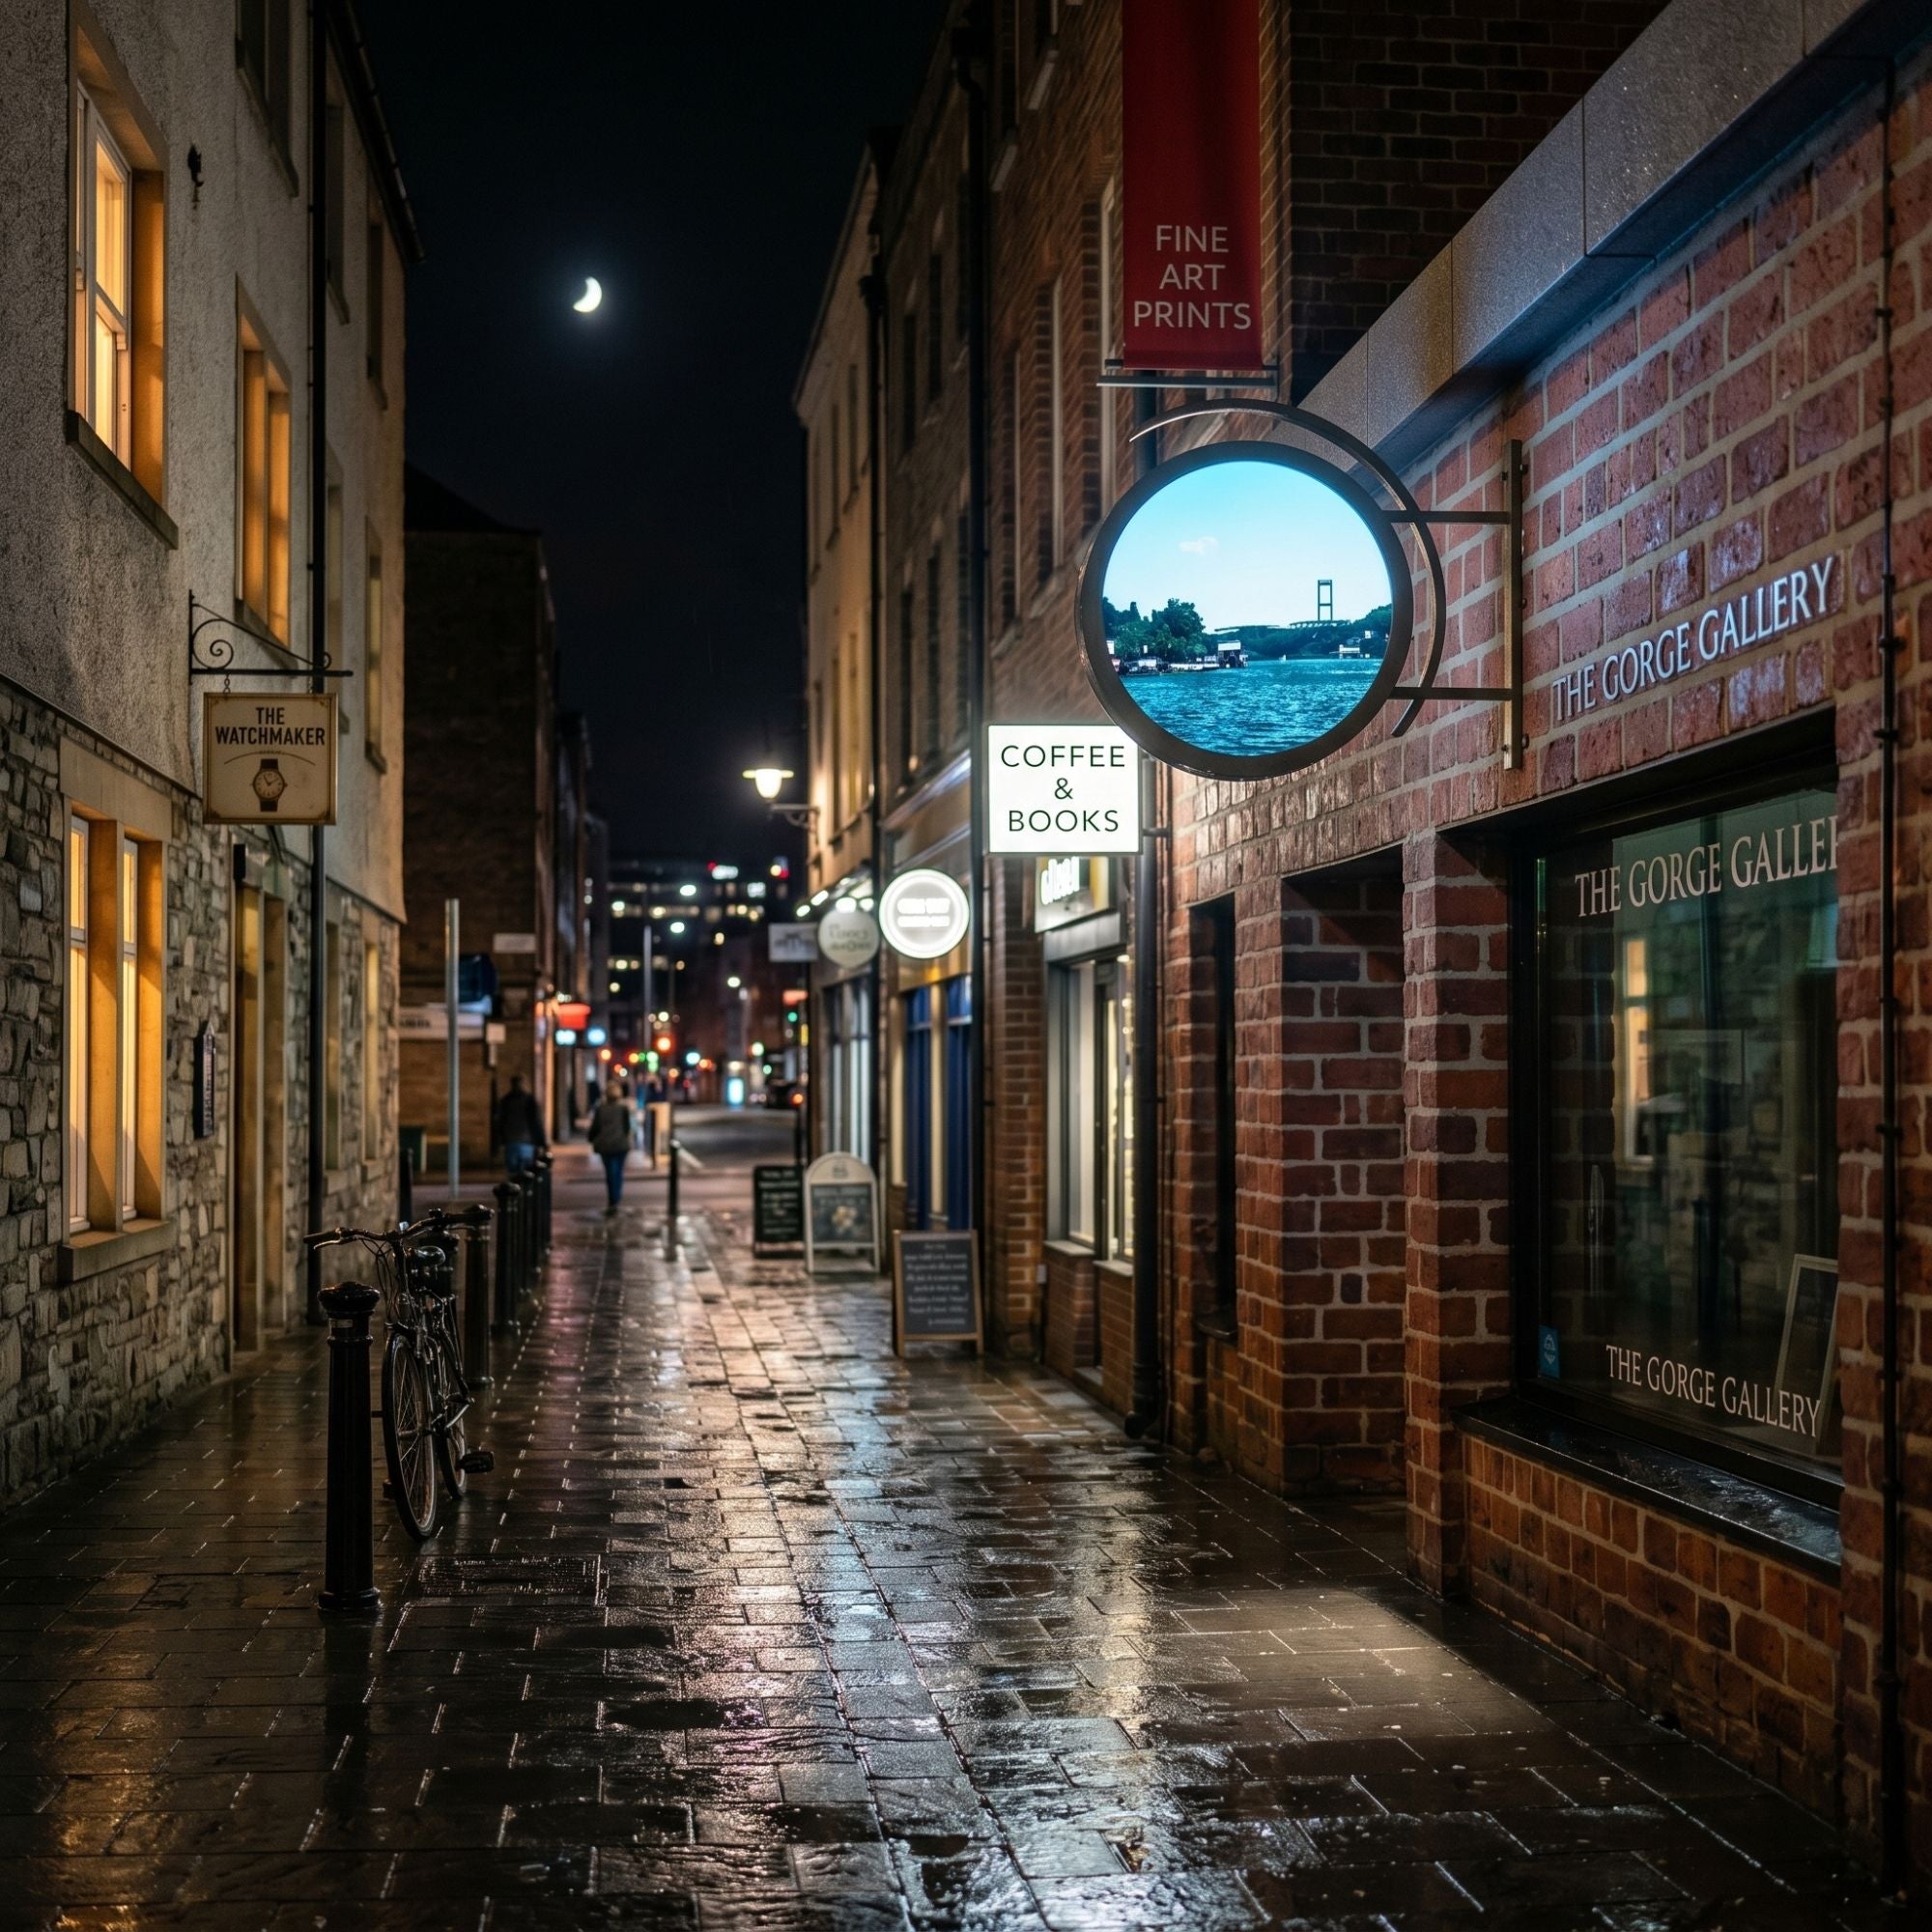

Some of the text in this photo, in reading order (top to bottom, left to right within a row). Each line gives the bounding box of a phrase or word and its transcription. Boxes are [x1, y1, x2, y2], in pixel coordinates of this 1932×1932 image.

[1156, 225, 1229, 252] FINE
[1159, 264, 1226, 291] ART
[1134, 300, 1252, 329] PRINTS
[1552, 555, 1833, 722] THE GORGE GALLERY
[255, 706, 285, 725] THE
[214, 725, 326, 746] WATCHMAKER
[1001, 745, 1125, 768] COFFEE
[1054, 778, 1074, 800] &
[1009, 810, 1120, 833] BOOKS
[1575, 865, 1621, 918] THE
[1629, 842, 1722, 908] GORGE
[1605, 1344, 1821, 1437] THE GORGE GALLERY
